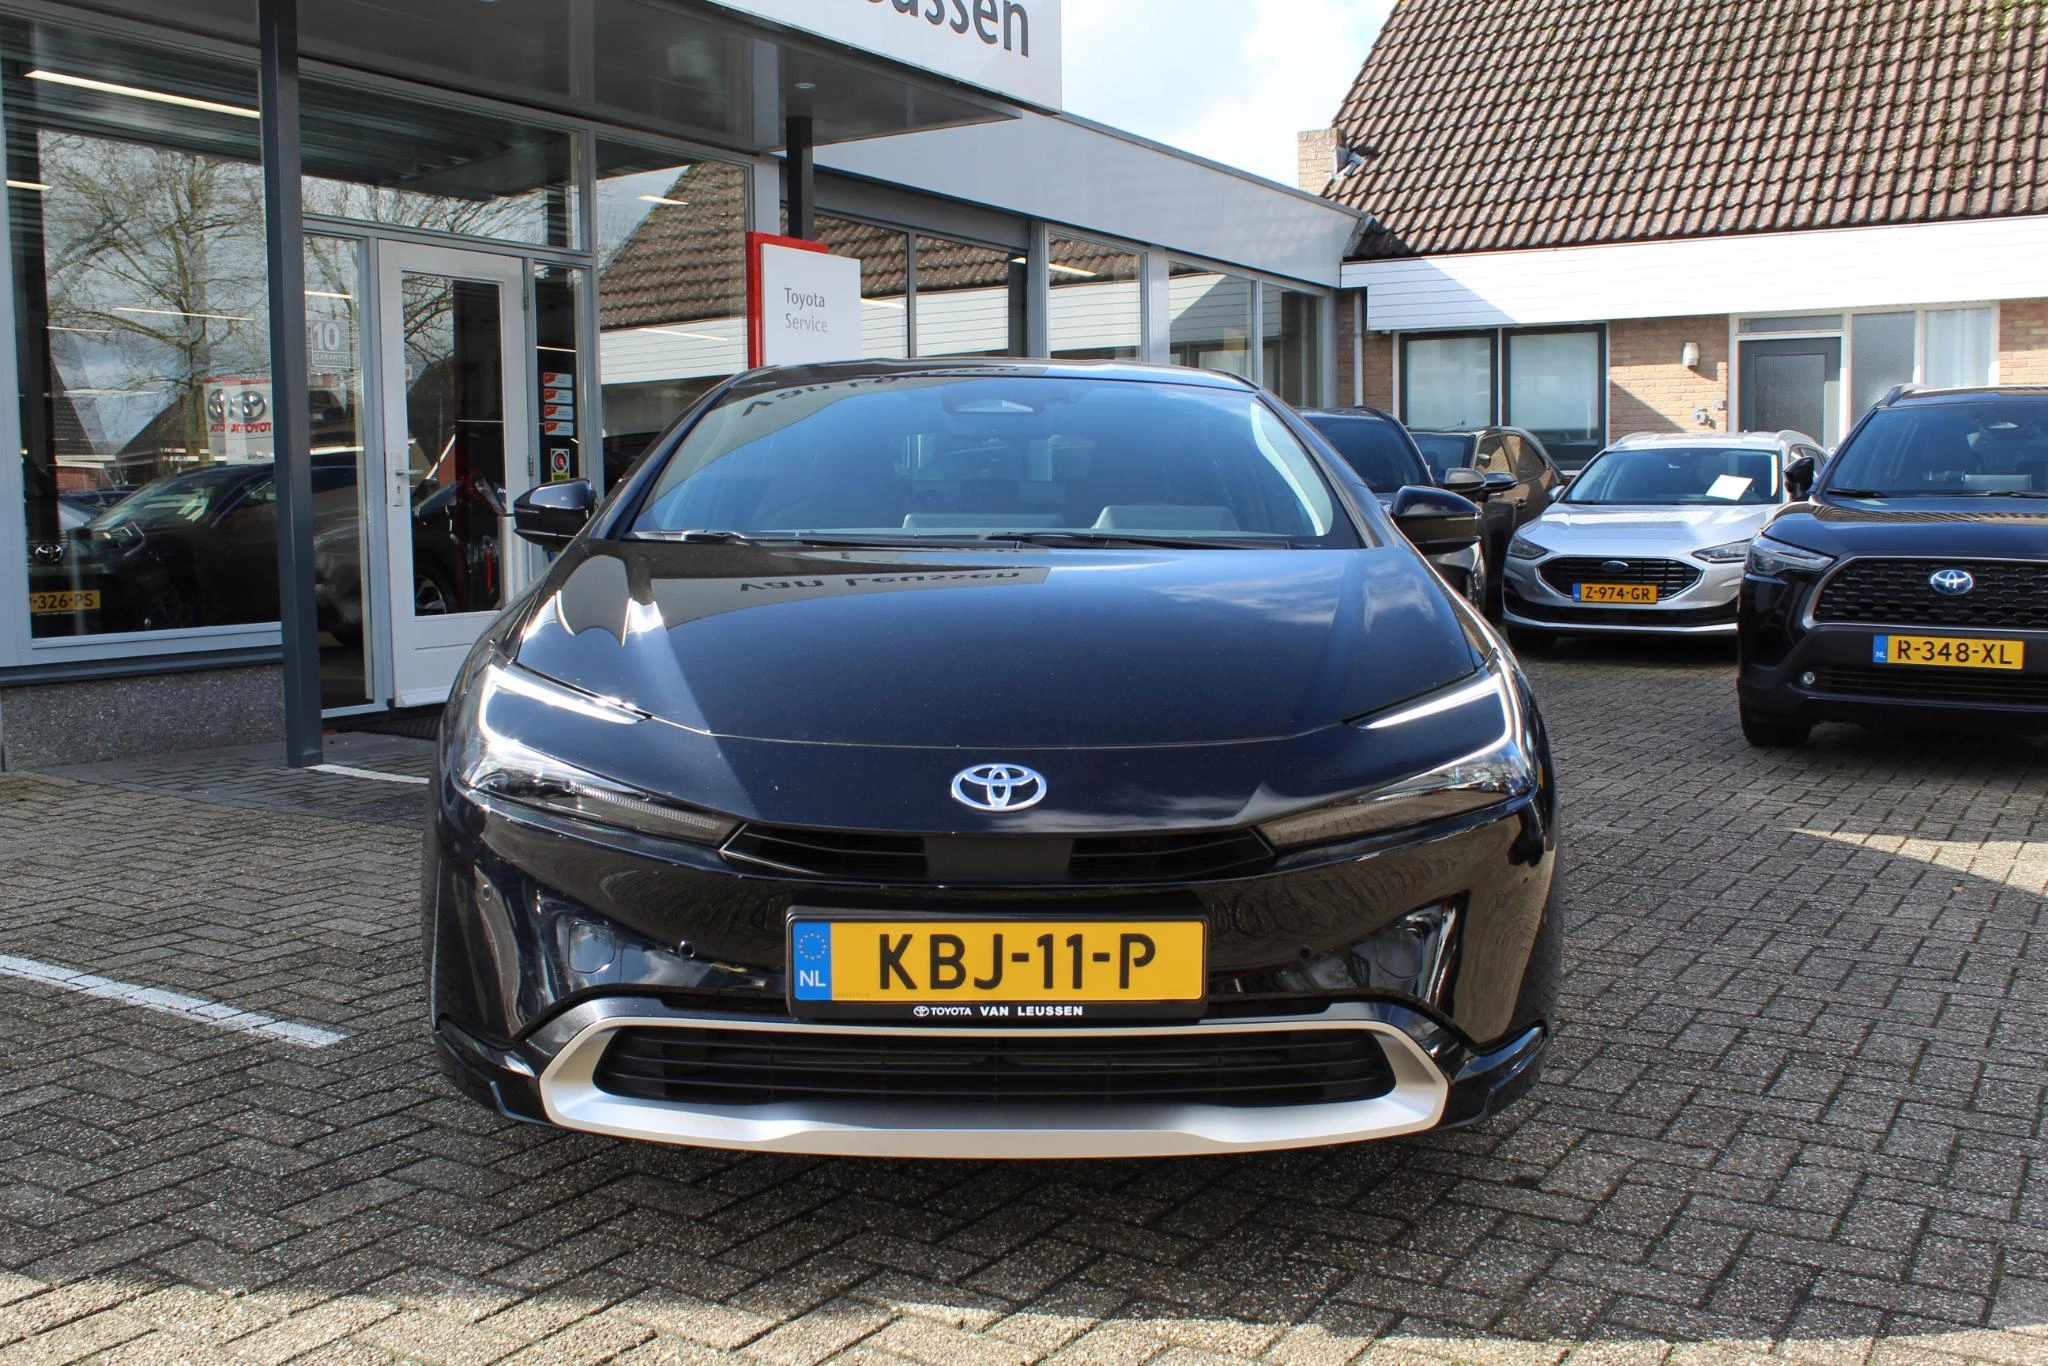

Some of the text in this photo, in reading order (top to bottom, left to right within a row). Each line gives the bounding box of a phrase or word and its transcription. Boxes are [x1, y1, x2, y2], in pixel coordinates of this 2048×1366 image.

[783, 287, 825, 310] Toyota
[785, 312, 828, 333] Service
[313, 322, 340, 351] 10
[30, 592, 94, 609] -326-PS
[1585, 586, 1650, 601] Z-974-GR
[1897, 639, 2013, 665] R-348-XL
[879, 933, 1156, 990] KBJ-11-P
[799, 969, 827, 987] NL
[930, 1006, 1083, 1016] TOYOTA VAN LEUSSEN
